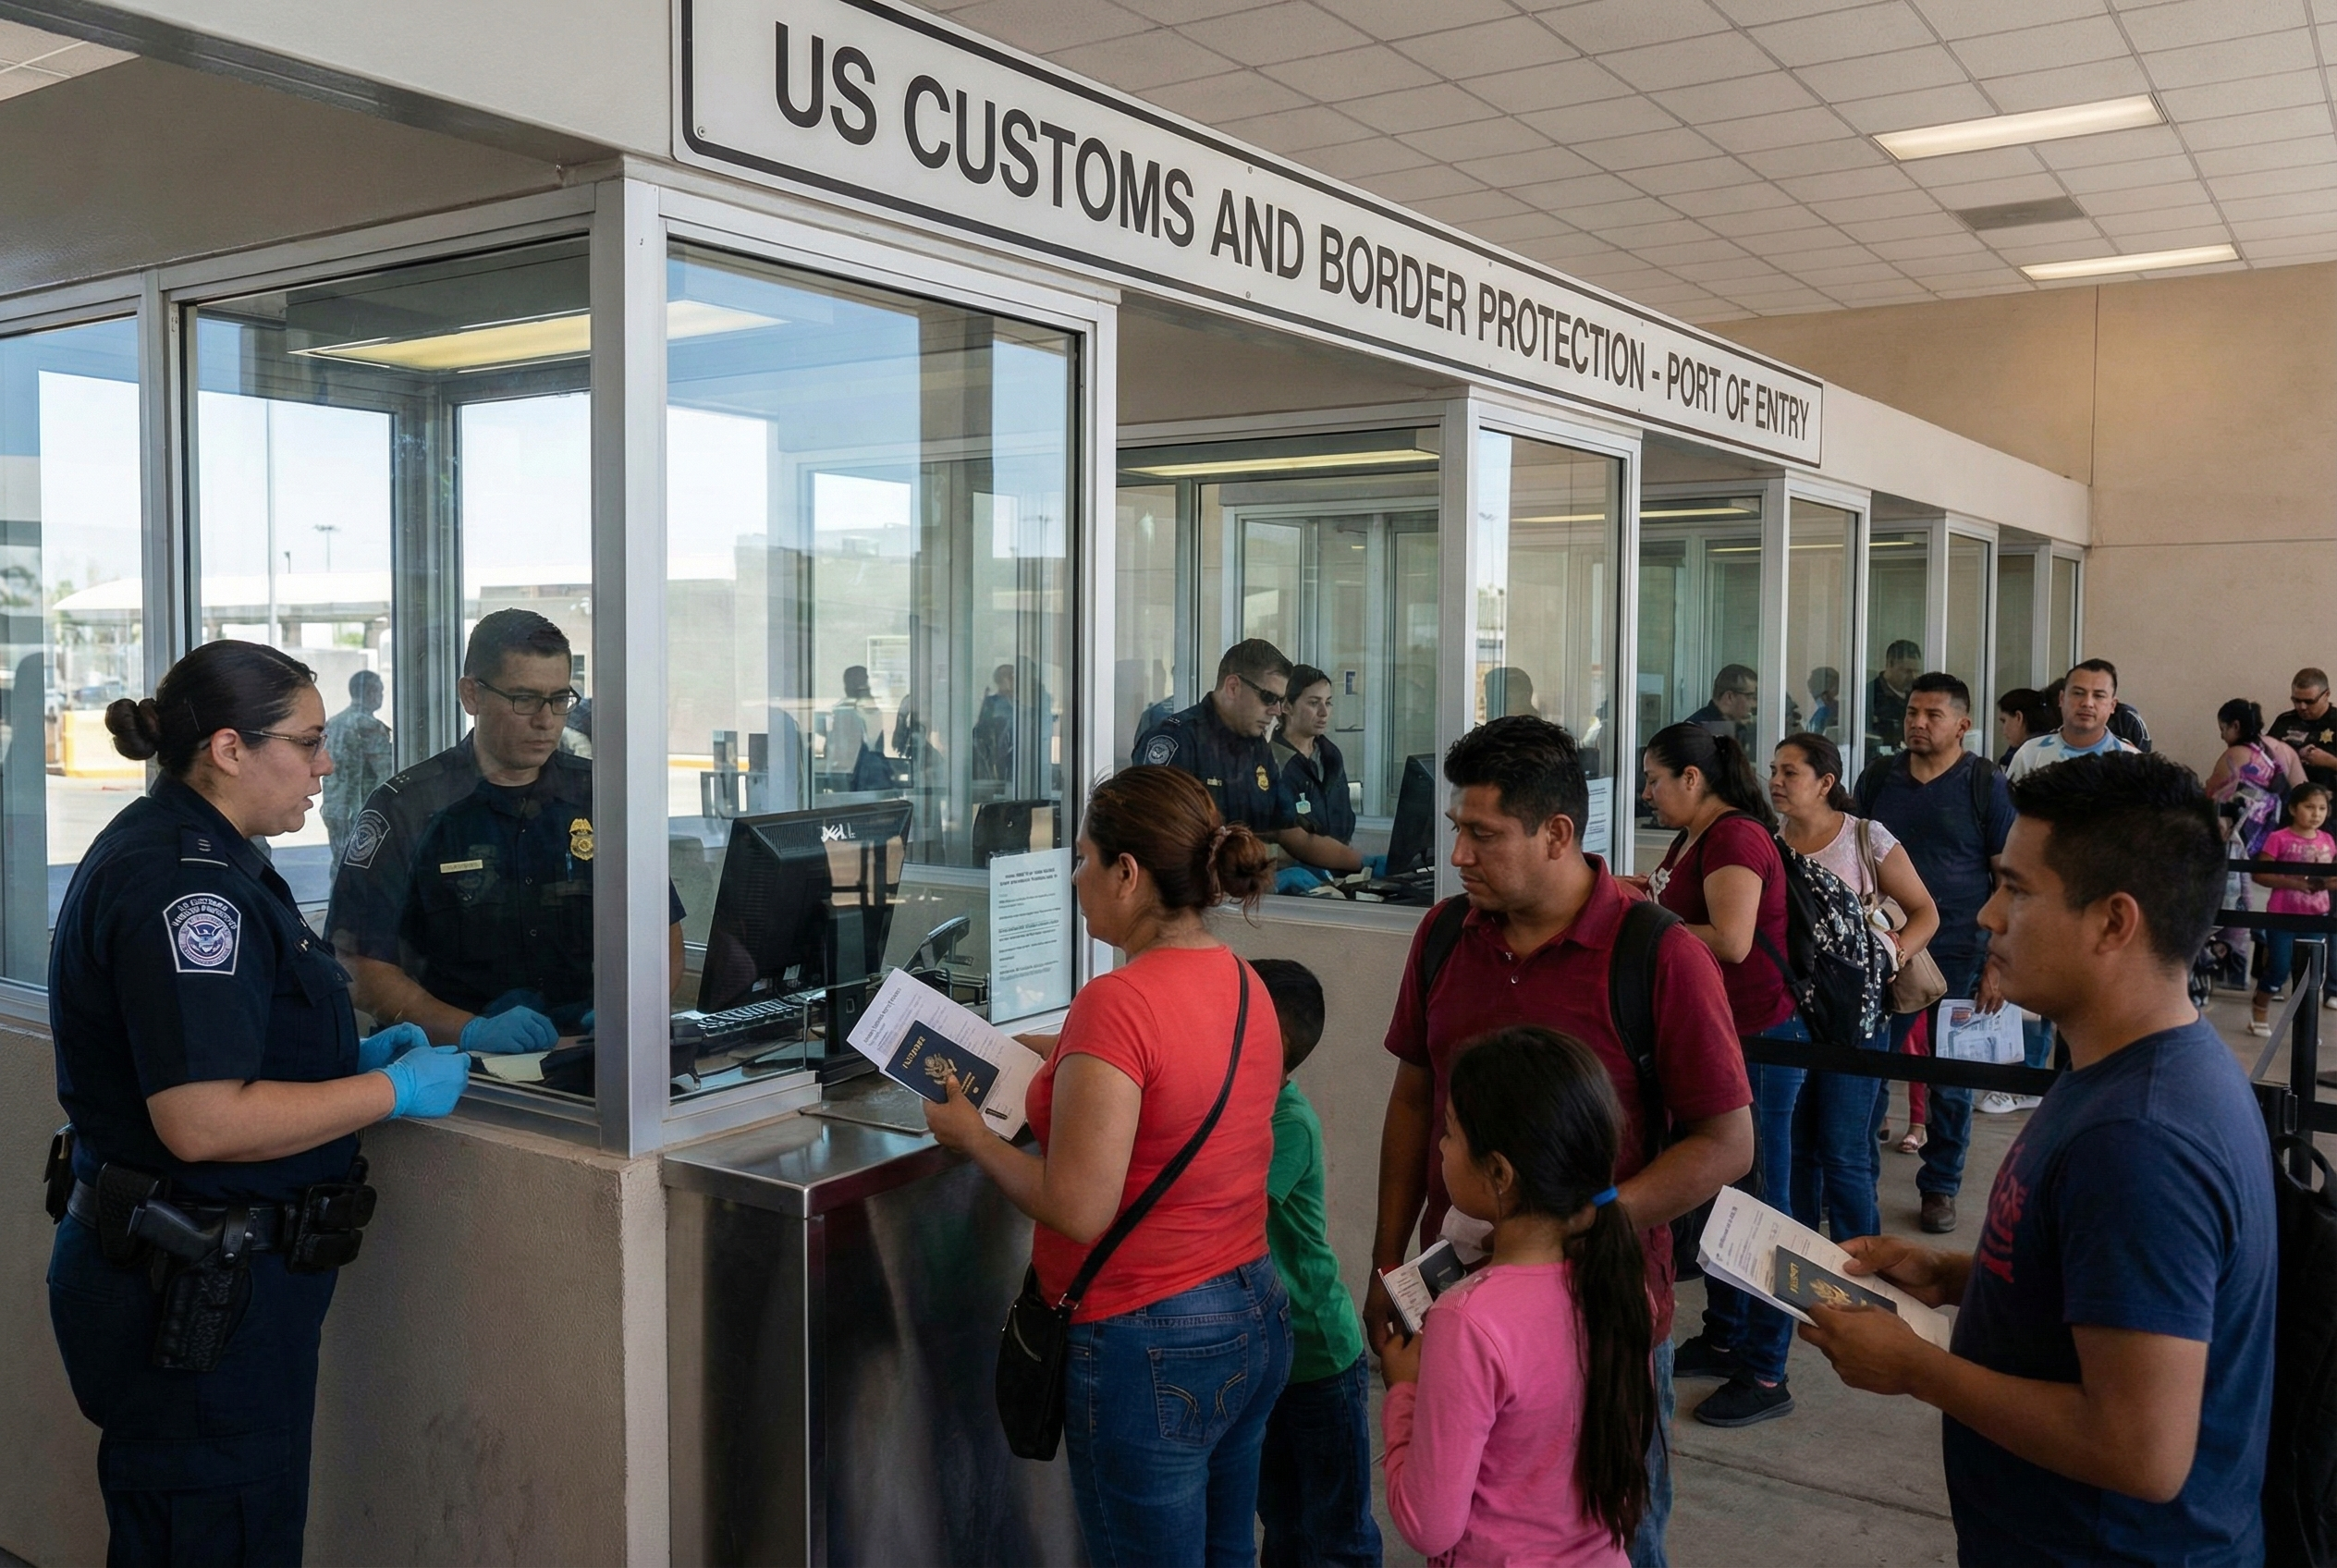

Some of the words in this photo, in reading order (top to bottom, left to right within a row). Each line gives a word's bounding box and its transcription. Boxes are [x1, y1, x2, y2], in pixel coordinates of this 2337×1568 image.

[775, 20, 877, 146] US
[903, 74, 1194, 248] CUSTOMS
[1210, 188, 1304, 280] AND
[1319, 223, 1467, 336] BORDER
[1478, 282, 1645, 392] PROTECTION
[1651, 370, 1660, 381] -
[1667, 351, 1721, 414] PORT
[1726, 374, 1751, 423] OF
[1756, 383, 1809, 441] ENTRY
